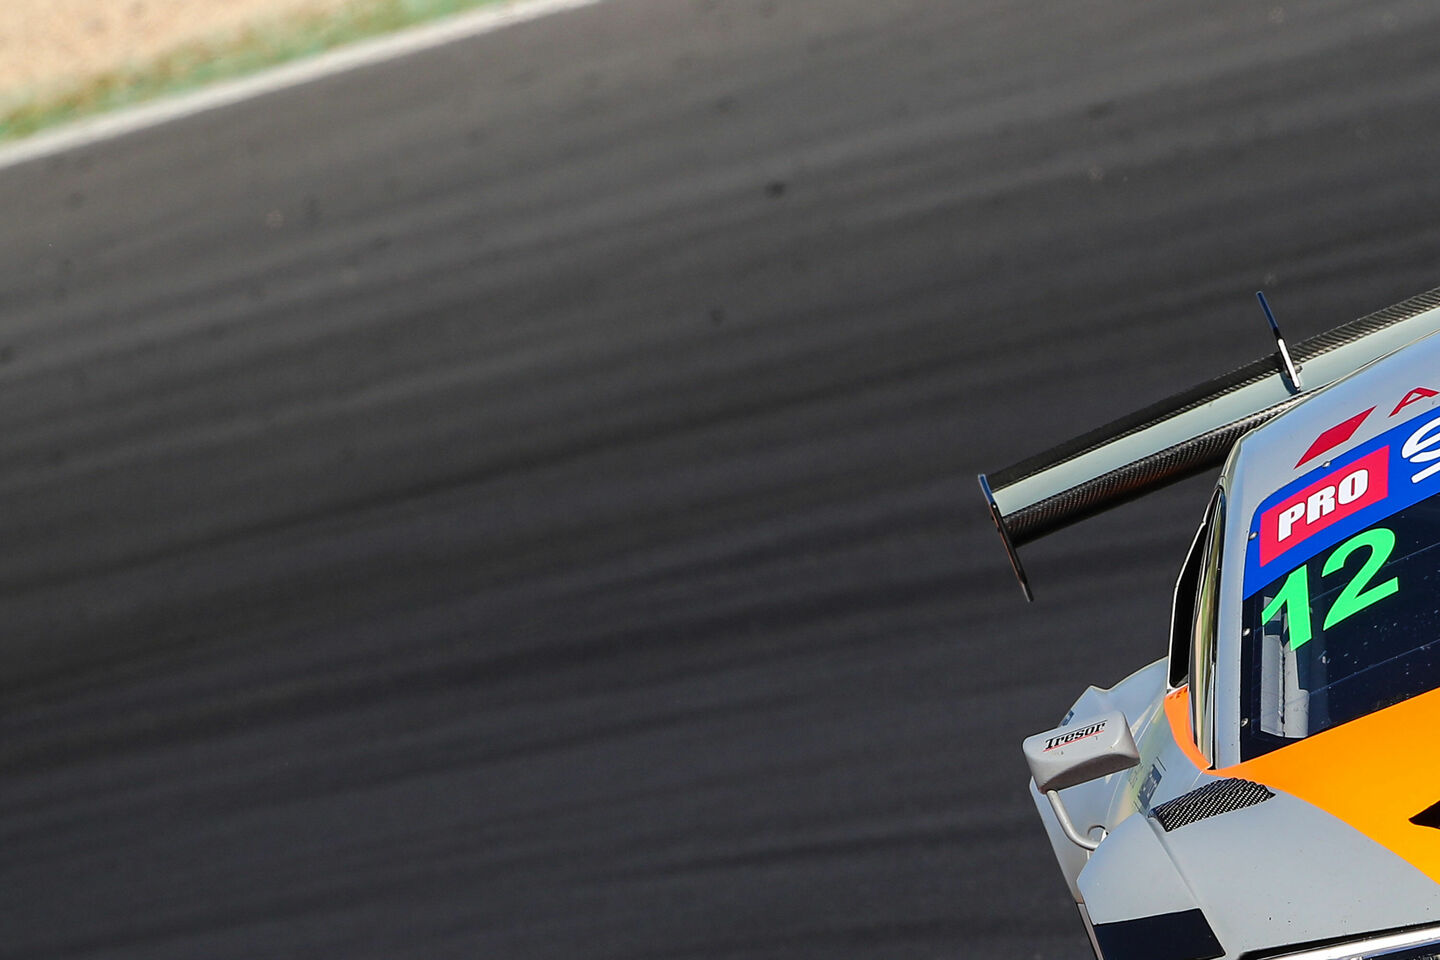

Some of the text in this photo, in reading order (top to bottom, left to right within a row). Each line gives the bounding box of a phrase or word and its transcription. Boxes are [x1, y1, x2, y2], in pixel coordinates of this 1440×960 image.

[1276, 467, 1371, 543] PRO
[1261, 527, 1400, 652] 12
[1043, 720, 1106, 752] Tresor
